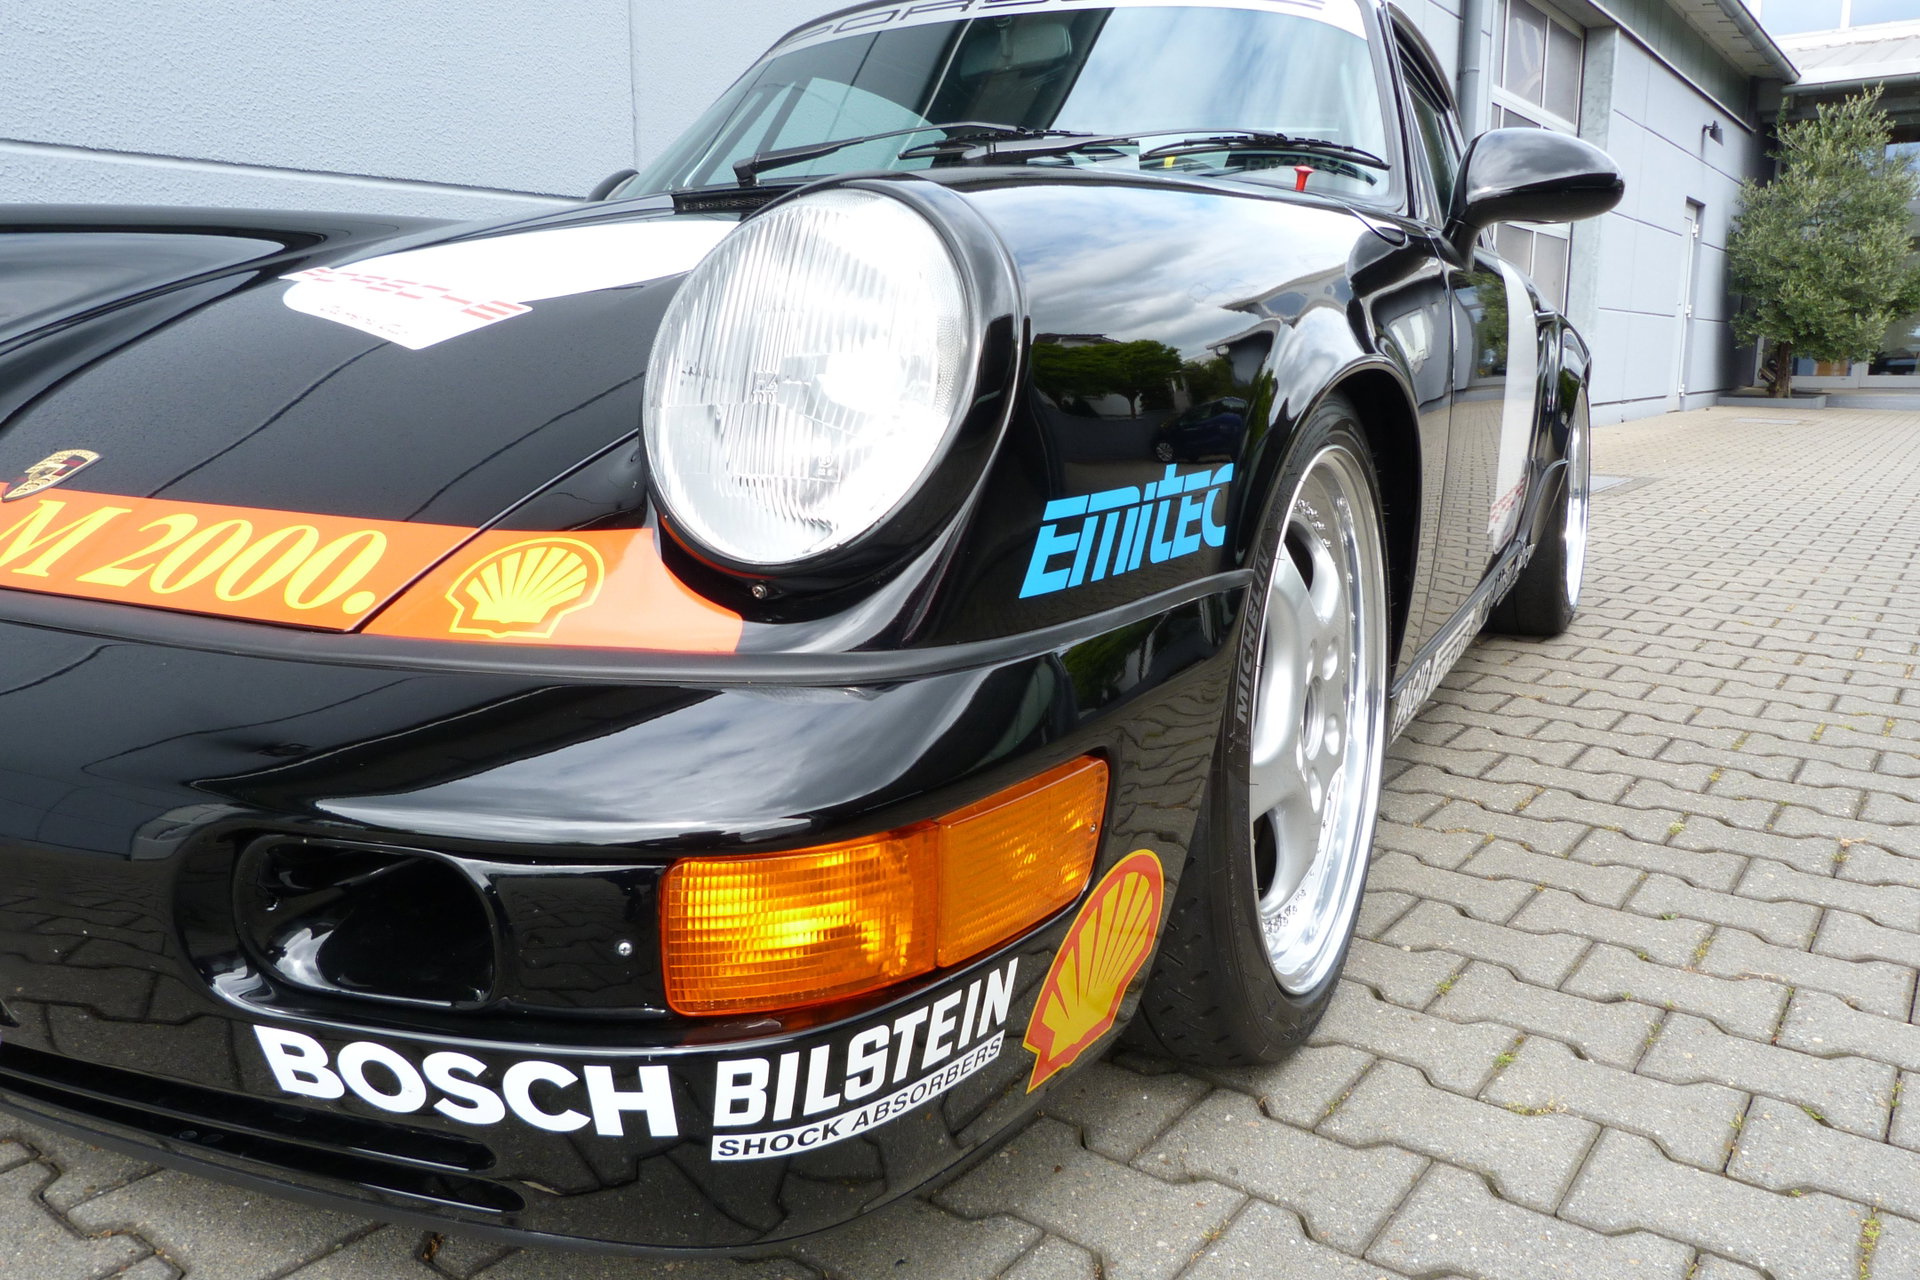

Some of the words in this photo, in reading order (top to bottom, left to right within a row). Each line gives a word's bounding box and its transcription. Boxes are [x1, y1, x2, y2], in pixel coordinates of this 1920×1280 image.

[75, 512, 387, 614] 2000.
[1236, 543, 1272, 725] MICHELIN
[254, 1025, 678, 1137] BOSCH
[713, 957, 1018, 1127] BILSTEIN
[718, 1118, 842, 1157] SHOCK
[851, 1036, 1002, 1131] ABSORBERS
